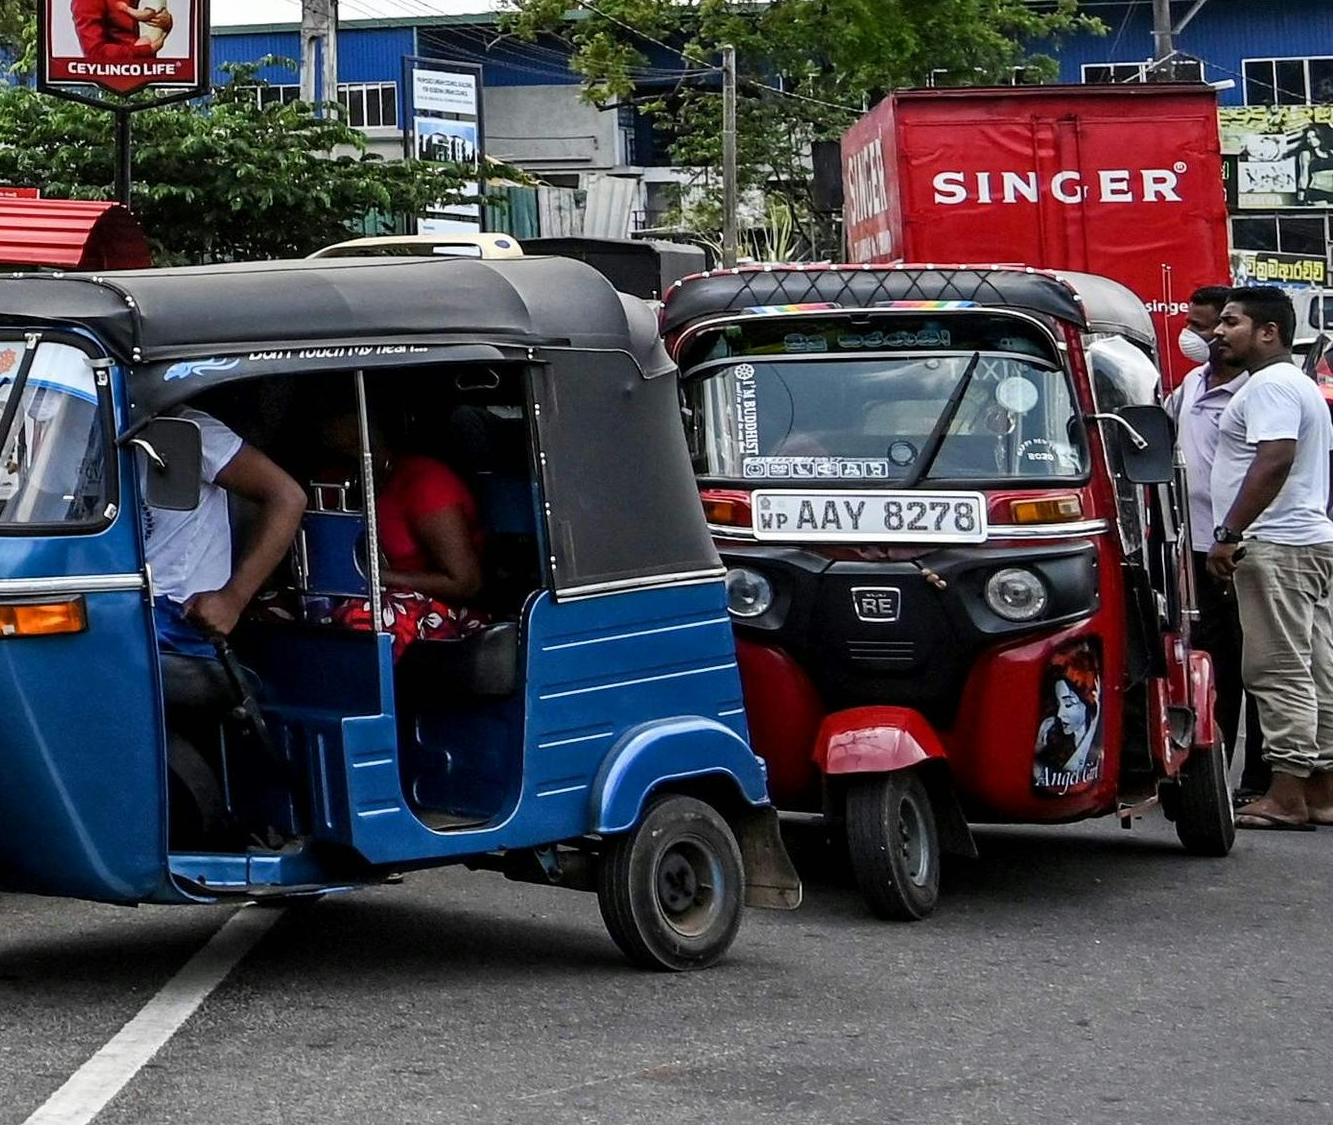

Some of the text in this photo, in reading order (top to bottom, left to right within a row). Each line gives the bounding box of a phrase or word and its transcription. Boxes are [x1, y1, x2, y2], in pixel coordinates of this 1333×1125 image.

[68, 61, 175, 76] CEYLINCO LIFE
[848, 138, 888, 227] SINGER
[933, 169, 1182, 205] SINGER
[742, 380, 759, 456] I'M BUDDHIST
[761, 500, 975, 531] WP AAY 8278
[861, 598, 894, 615] RE
